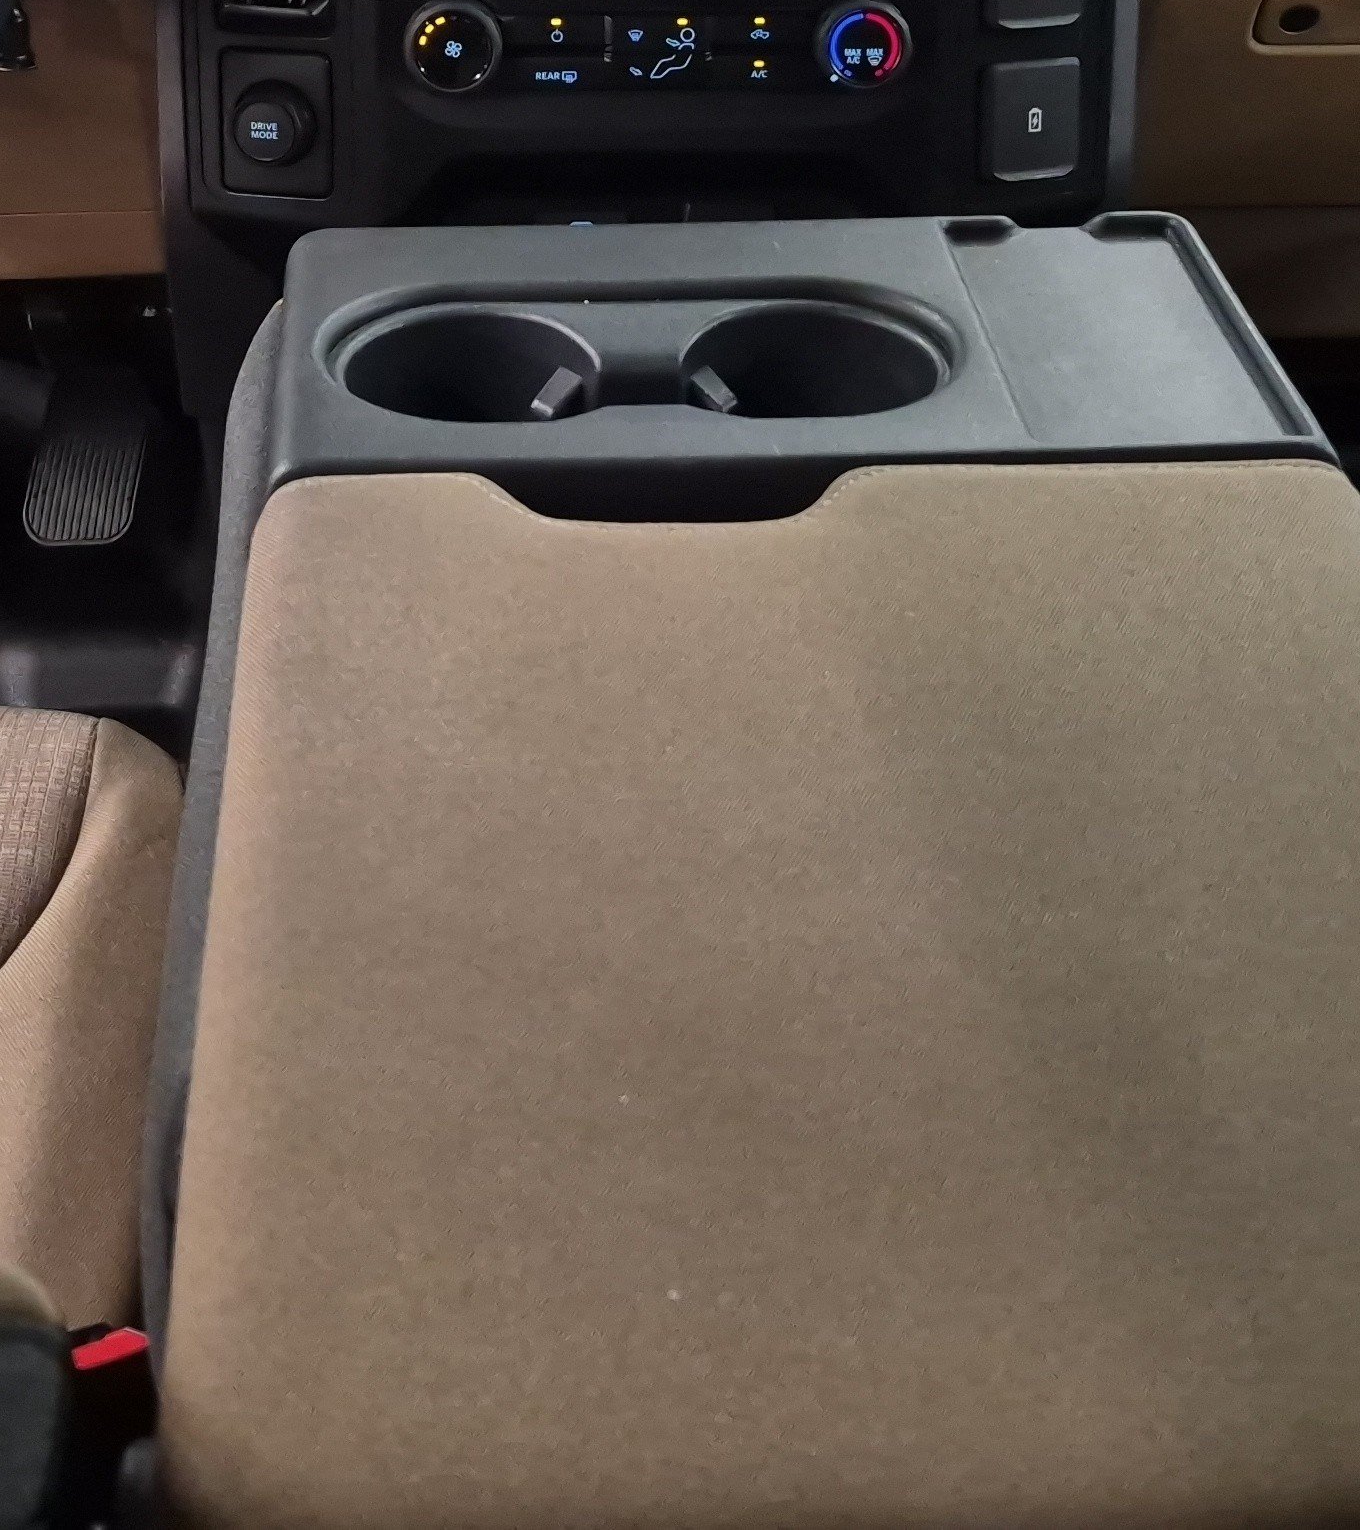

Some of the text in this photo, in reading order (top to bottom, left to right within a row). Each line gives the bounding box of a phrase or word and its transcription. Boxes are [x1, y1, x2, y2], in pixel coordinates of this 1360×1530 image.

[844, 48, 862, 57] MAX
[865, 48, 884, 57] MAX
[846, 56, 861, 65] A/C
[535, 71, 560, 80] REAR
[750, 69, 768, 78] A/C
[250, 121, 278, 131] DRIVE
[250, 130, 279, 140] MODE
